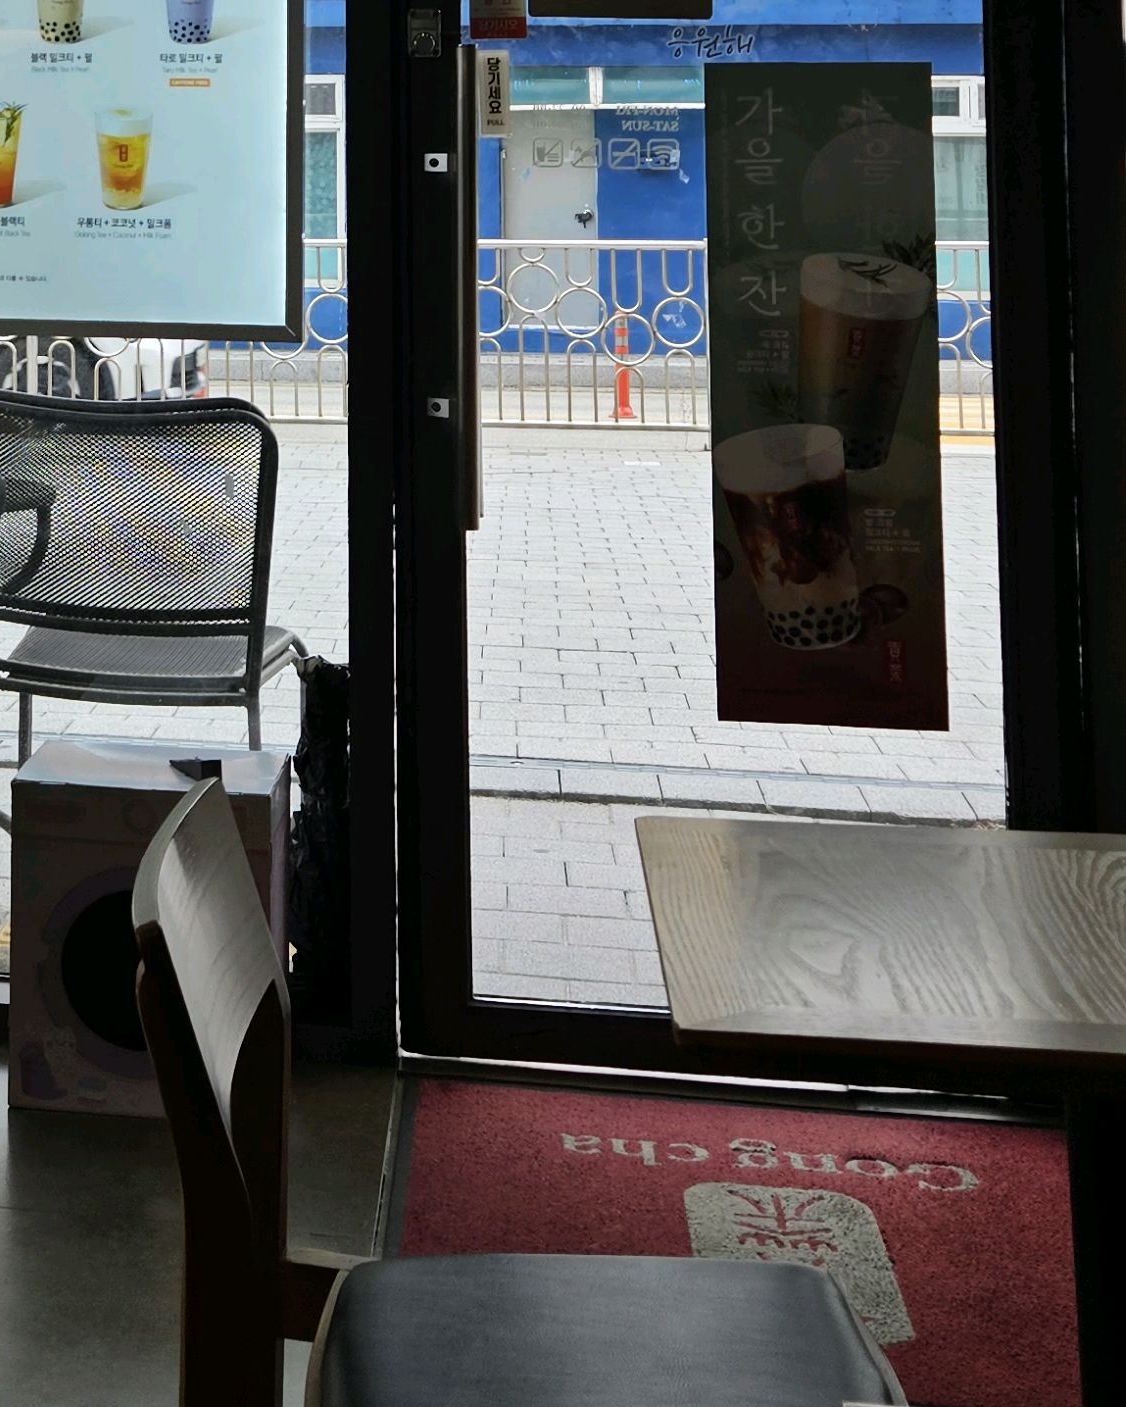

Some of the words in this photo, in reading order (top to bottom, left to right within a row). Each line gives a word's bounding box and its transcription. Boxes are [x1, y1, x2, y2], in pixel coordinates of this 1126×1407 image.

[666, 25, 756, 59] 응원해
[487, 57, 502, 114] 당기세요
[562, 1134, 712, 1166] cha
[729, 1138, 980, 1192] Gong
